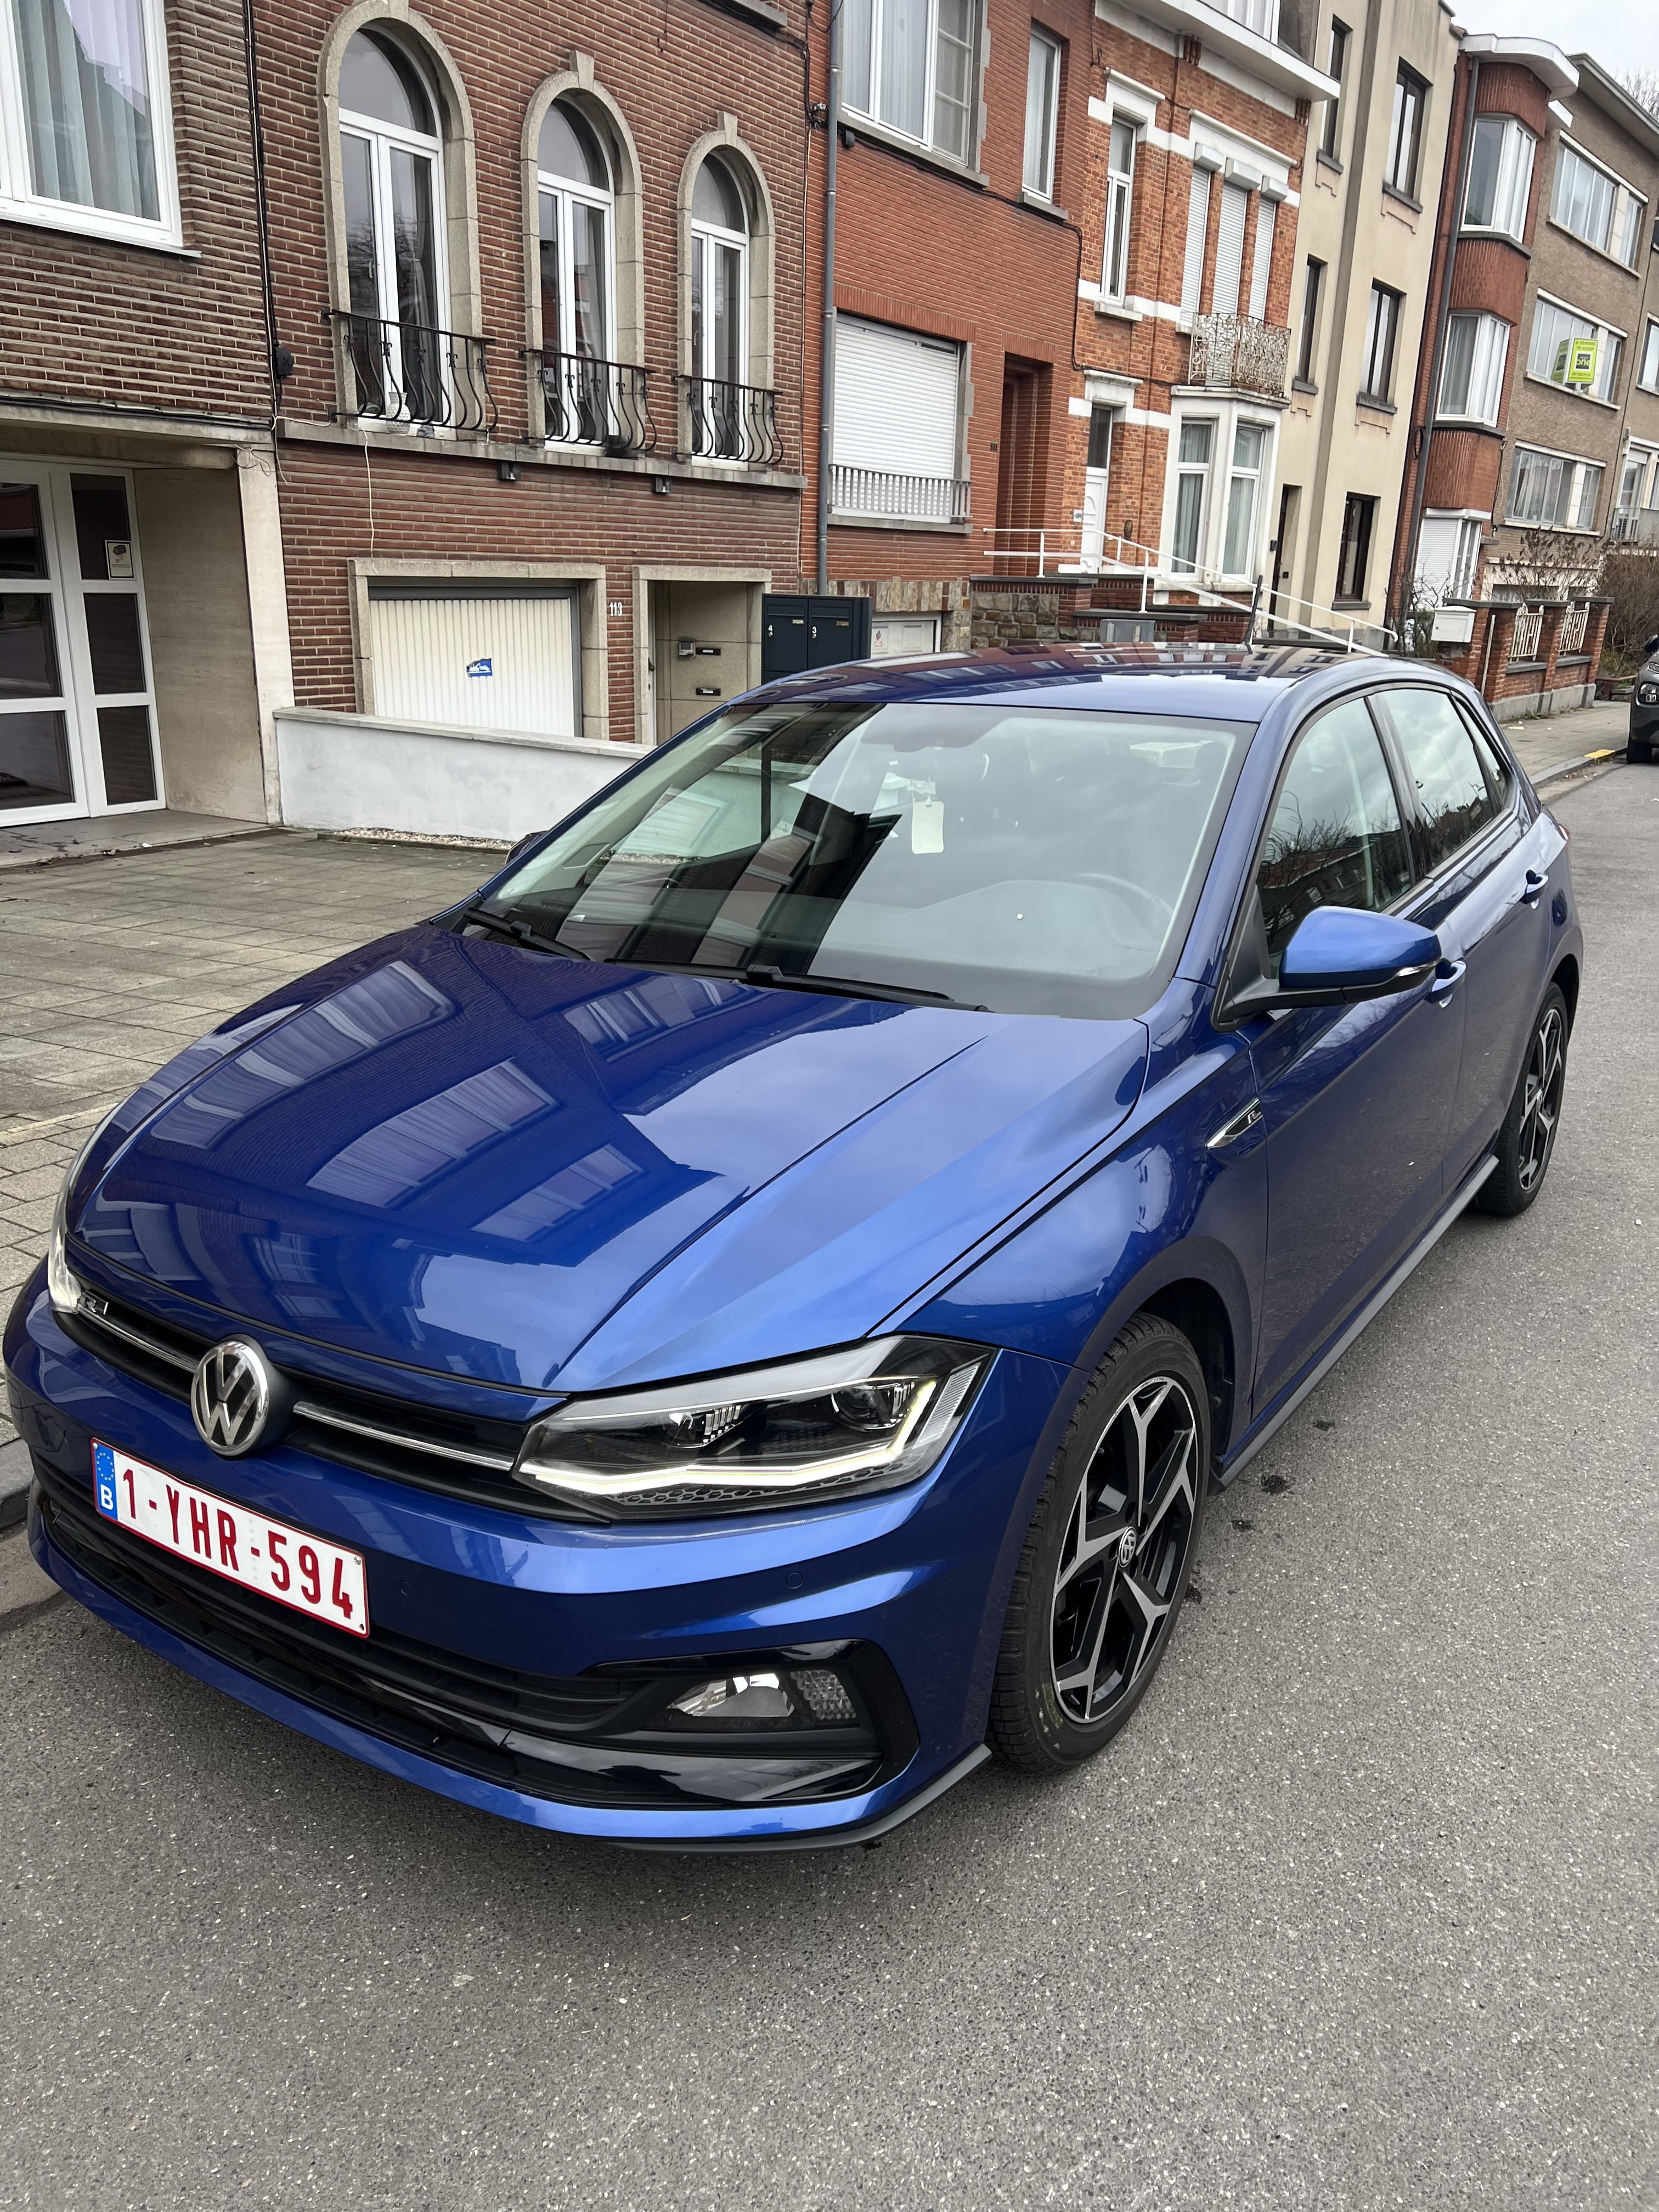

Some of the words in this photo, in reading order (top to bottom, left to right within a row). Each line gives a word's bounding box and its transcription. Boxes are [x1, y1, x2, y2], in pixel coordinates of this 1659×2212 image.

[610, 602, 622, 616] 113
[192, 1342, 268, 1455] VW
[100, 1484, 114, 1510] B
[123, 1469, 353, 1620] 1-YHR-594
[1120, 1527, 1136, 1566] VW
